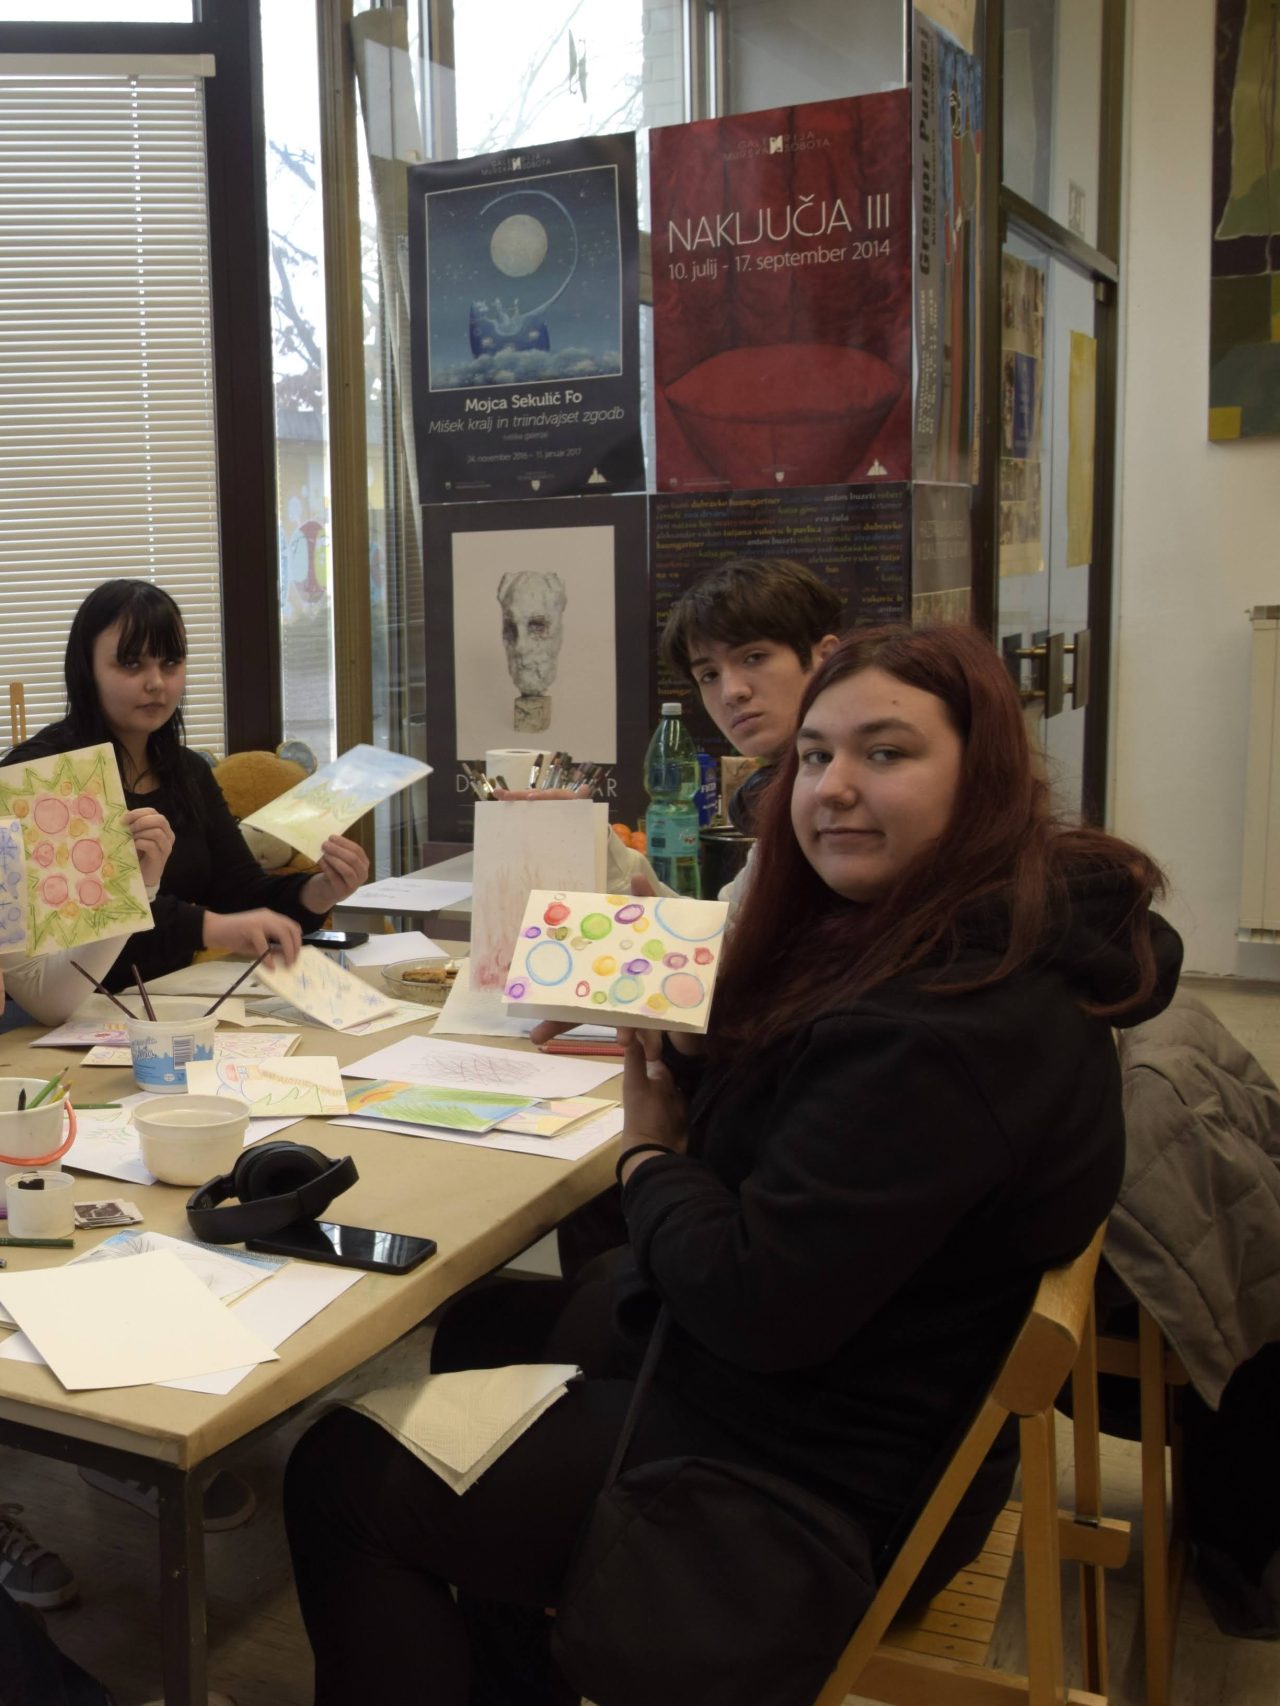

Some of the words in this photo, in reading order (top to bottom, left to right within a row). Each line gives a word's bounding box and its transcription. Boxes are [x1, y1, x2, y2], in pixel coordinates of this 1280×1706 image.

[667, 193, 852, 254] NAKLJUČJA
[867, 193, 891, 230] III
[668, 261, 689, 281] 10.
[692, 258, 718, 282] julij
[734, 253, 753, 273] 17.
[756, 244, 846, 272] september
[852, 240, 890, 261] 2014
[464, 396, 508, 414] Mojca
[565, 390, 583, 404] Fo
[428, 418, 465, 434] Mišek
[468, 417, 493, 433] kralj
[496, 415, 509, 430] in
[513, 410, 580, 428] triindvajset
[582, 406, 625, 425] zgodb
